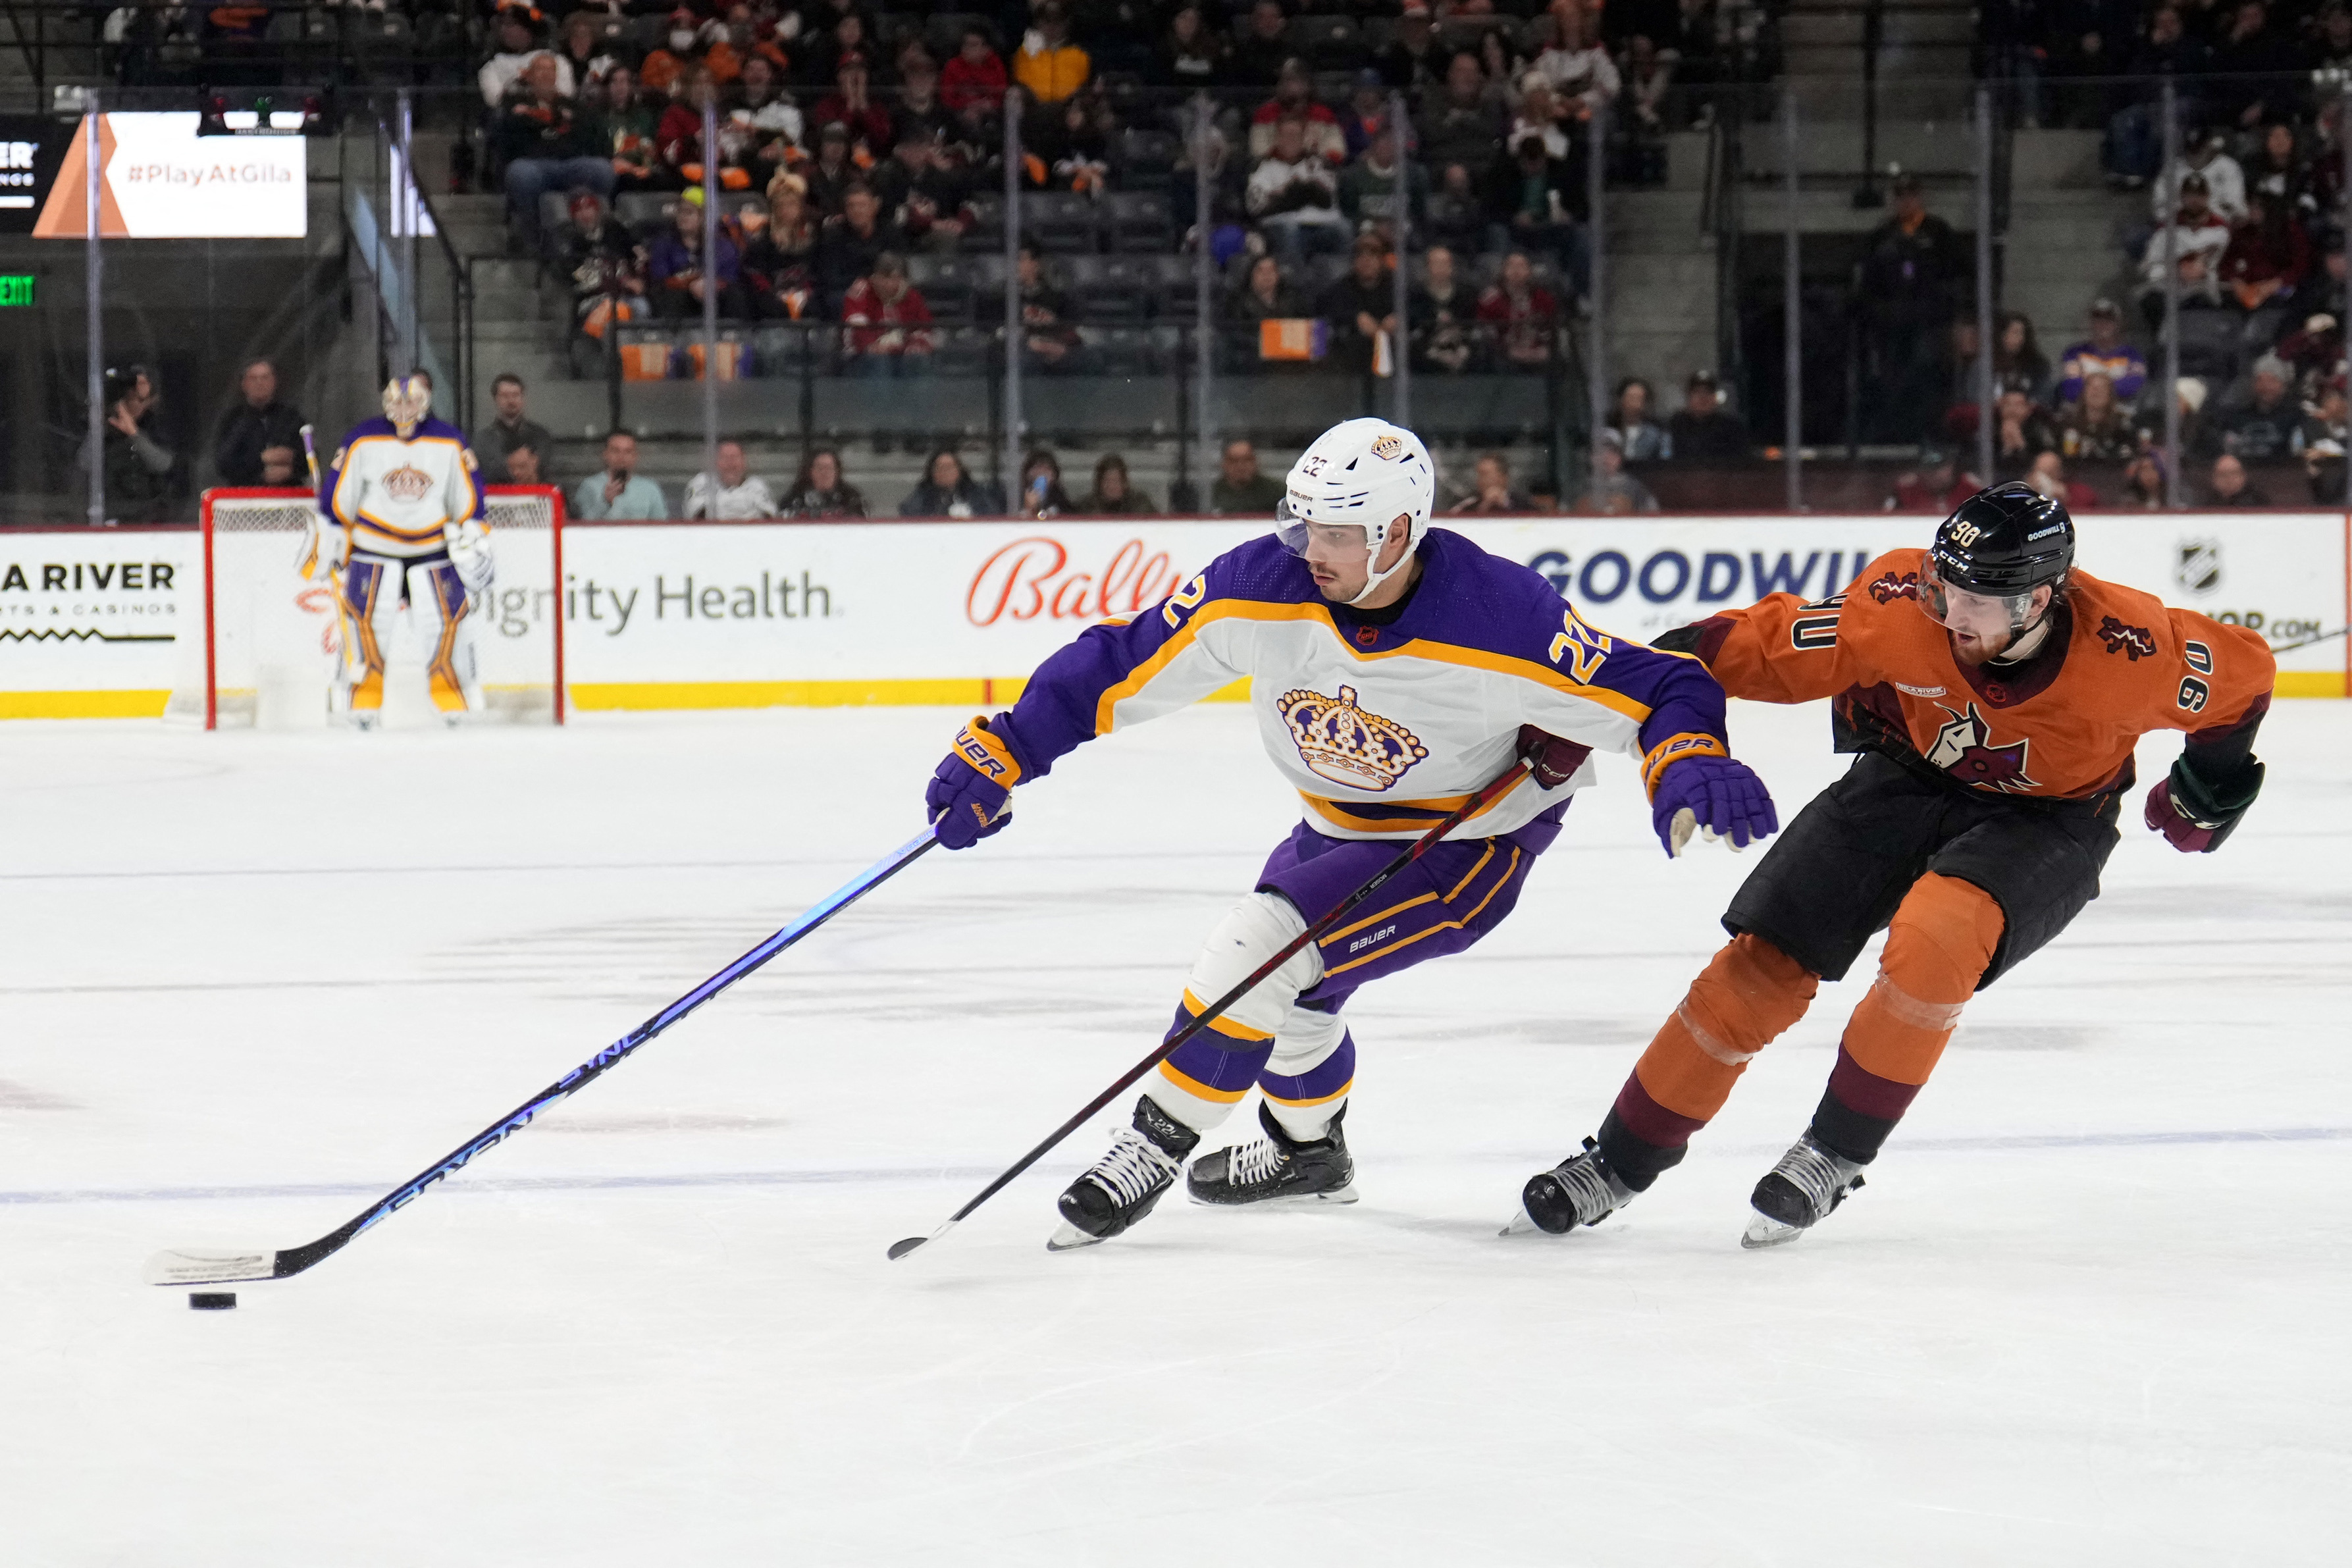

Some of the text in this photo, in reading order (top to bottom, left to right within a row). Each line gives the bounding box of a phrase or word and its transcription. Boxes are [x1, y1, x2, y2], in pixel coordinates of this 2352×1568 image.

[128, 164, 291, 186] #PlayAtGila
[1303, 456, 1328, 477] 22
[1289, 490, 1313, 503] BAUER
[1951, 521, 1981, 548] 90
[2027, 526, 2060, 542] GOODWILL
[1939, 550, 1969, 571] CCM
[43, 563, 174, 590] RIVER
[72, 605, 176, 615] CASINOS
[468, 570, 831, 637] ignity Health
[1548, 609, 1612, 685] 22
[1542, 764, 1570, 778] CCM
[1369, 873, 1388, 890] MOSER
[1350, 925, 1396, 953] BAUER
[1154, 1118, 1176, 1134] 22
